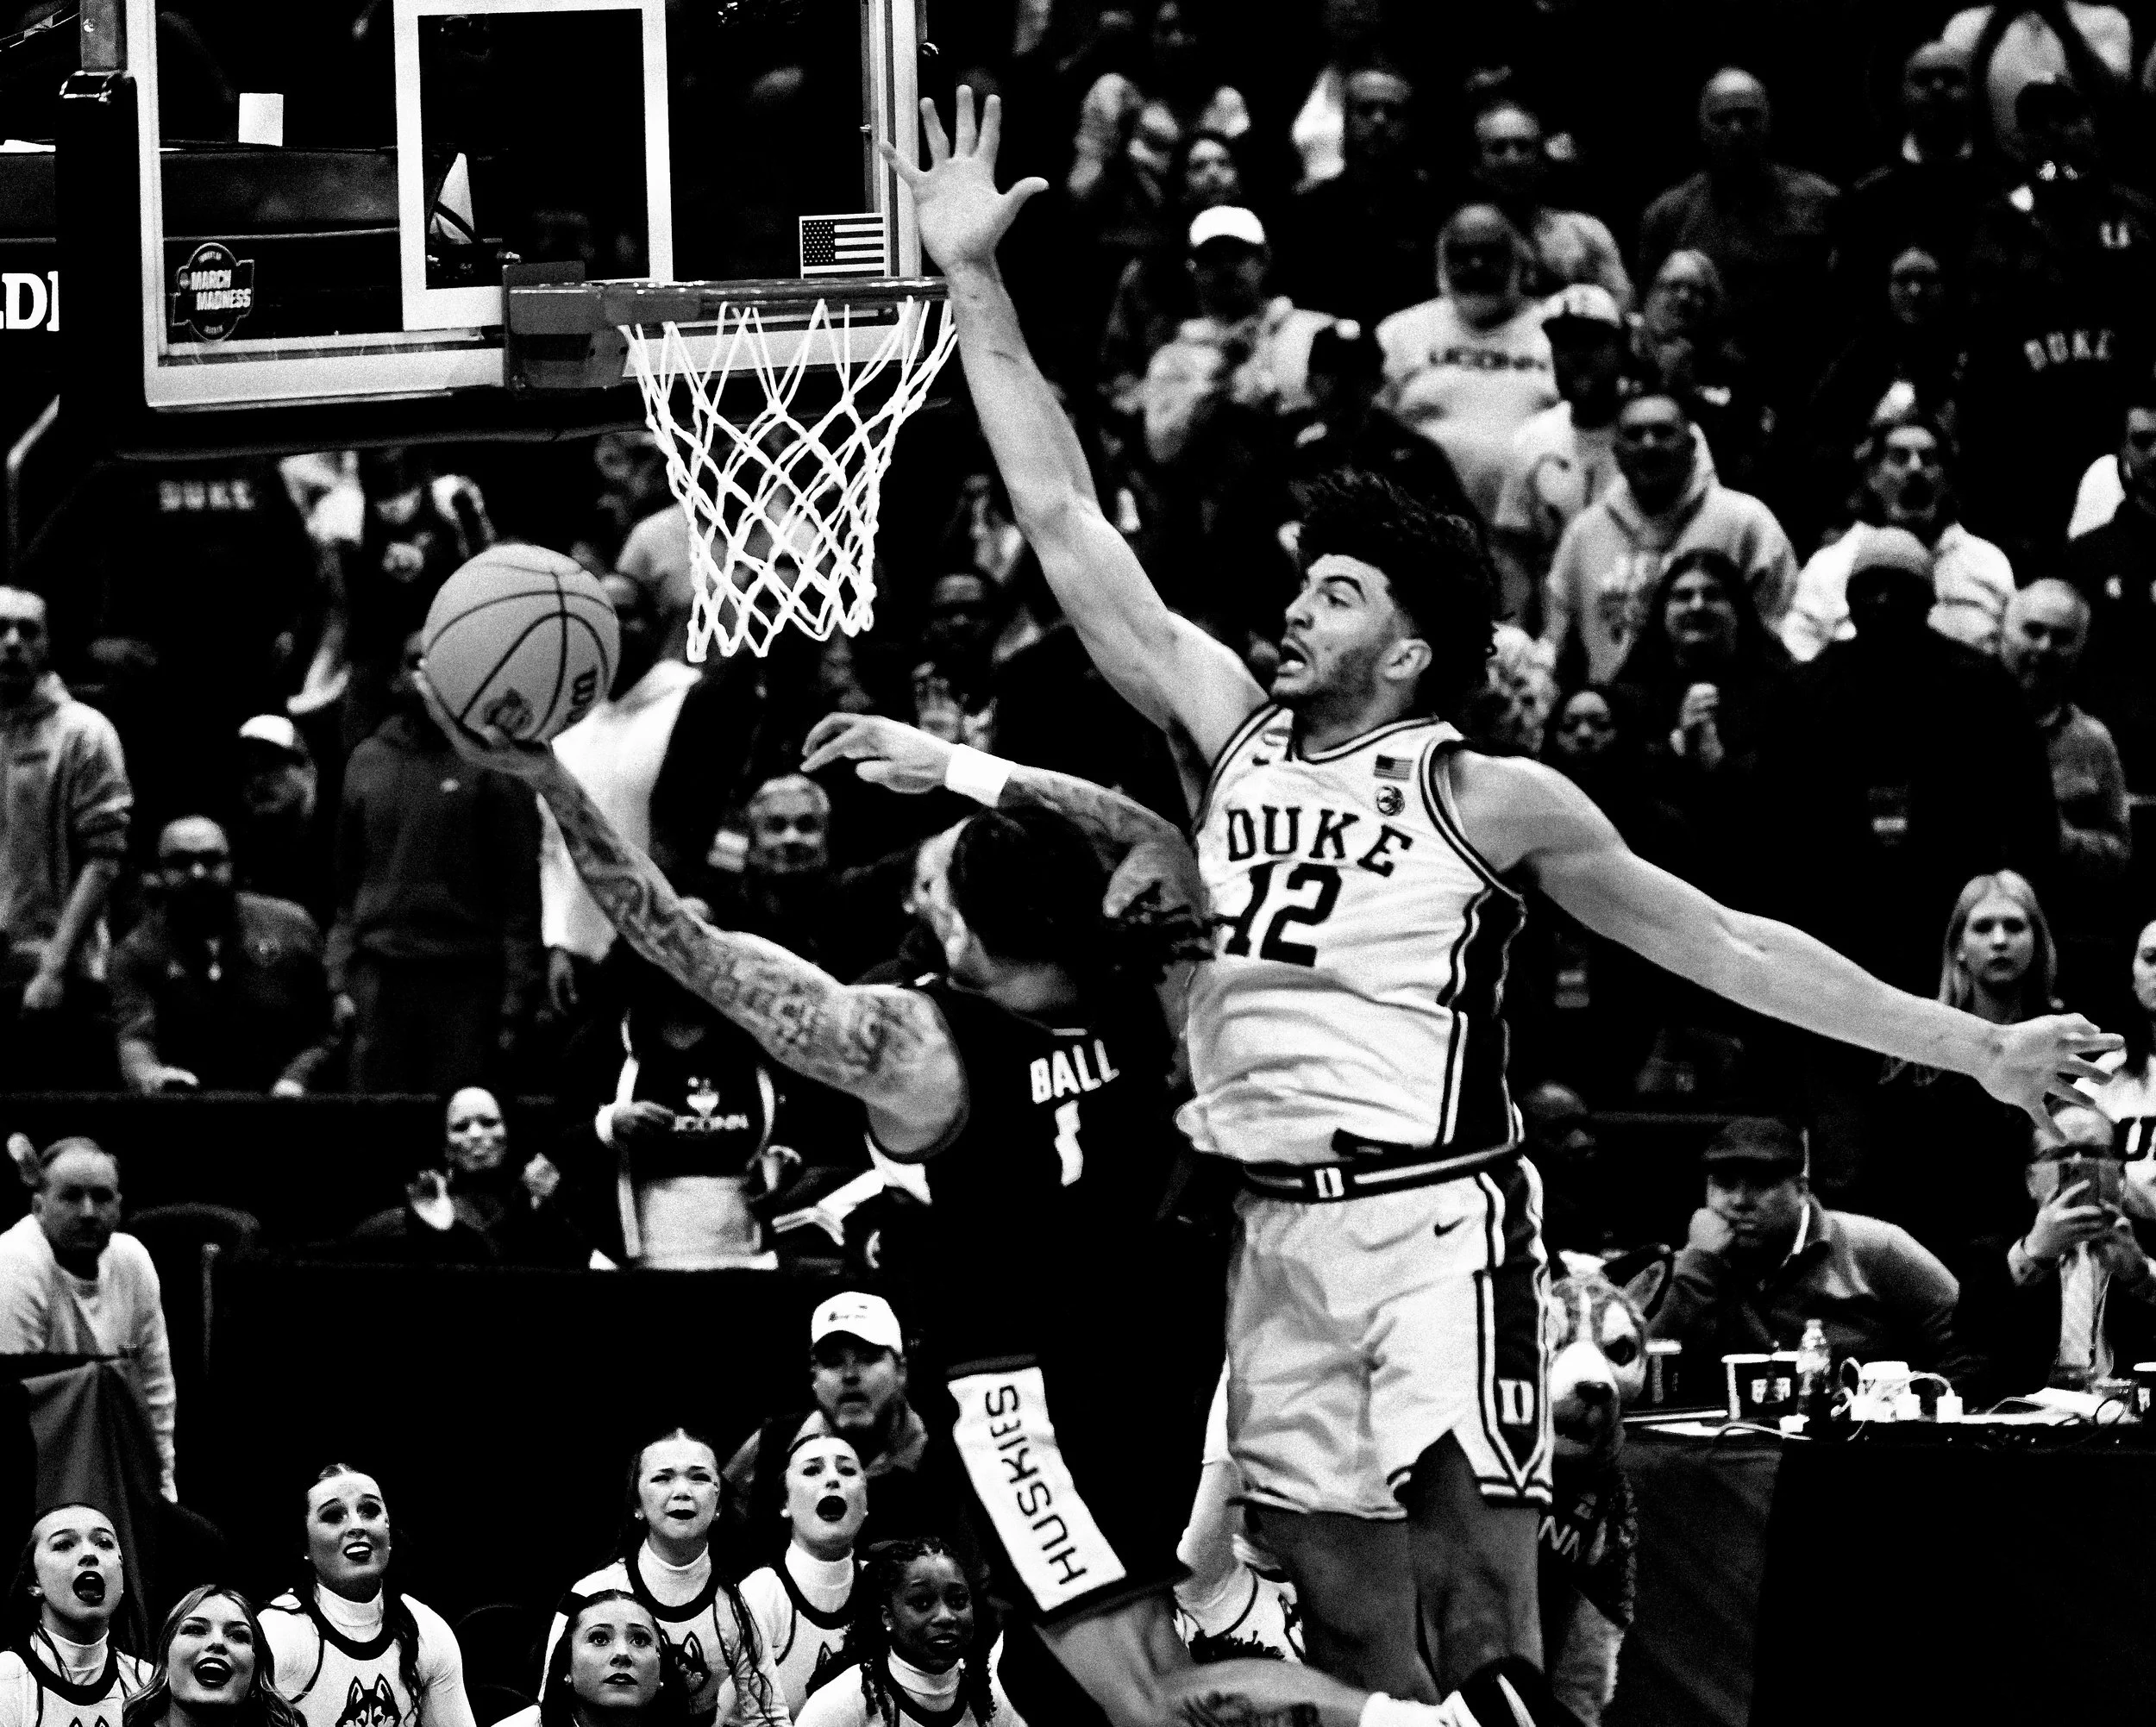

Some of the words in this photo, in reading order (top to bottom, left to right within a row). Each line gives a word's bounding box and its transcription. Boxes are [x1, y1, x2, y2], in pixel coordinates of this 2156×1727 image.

[191, 269, 232, 291] MARCH
[196, 288, 252, 311] MADNESS
[1225, 804, 1413, 878] DUKE
[1223, 861, 1343, 967] 12
[1030, 1038, 1120, 1104] BALL
[1497, 1378, 1535, 1425] D
[985, 1384, 1088, 1586] HUSKIES
